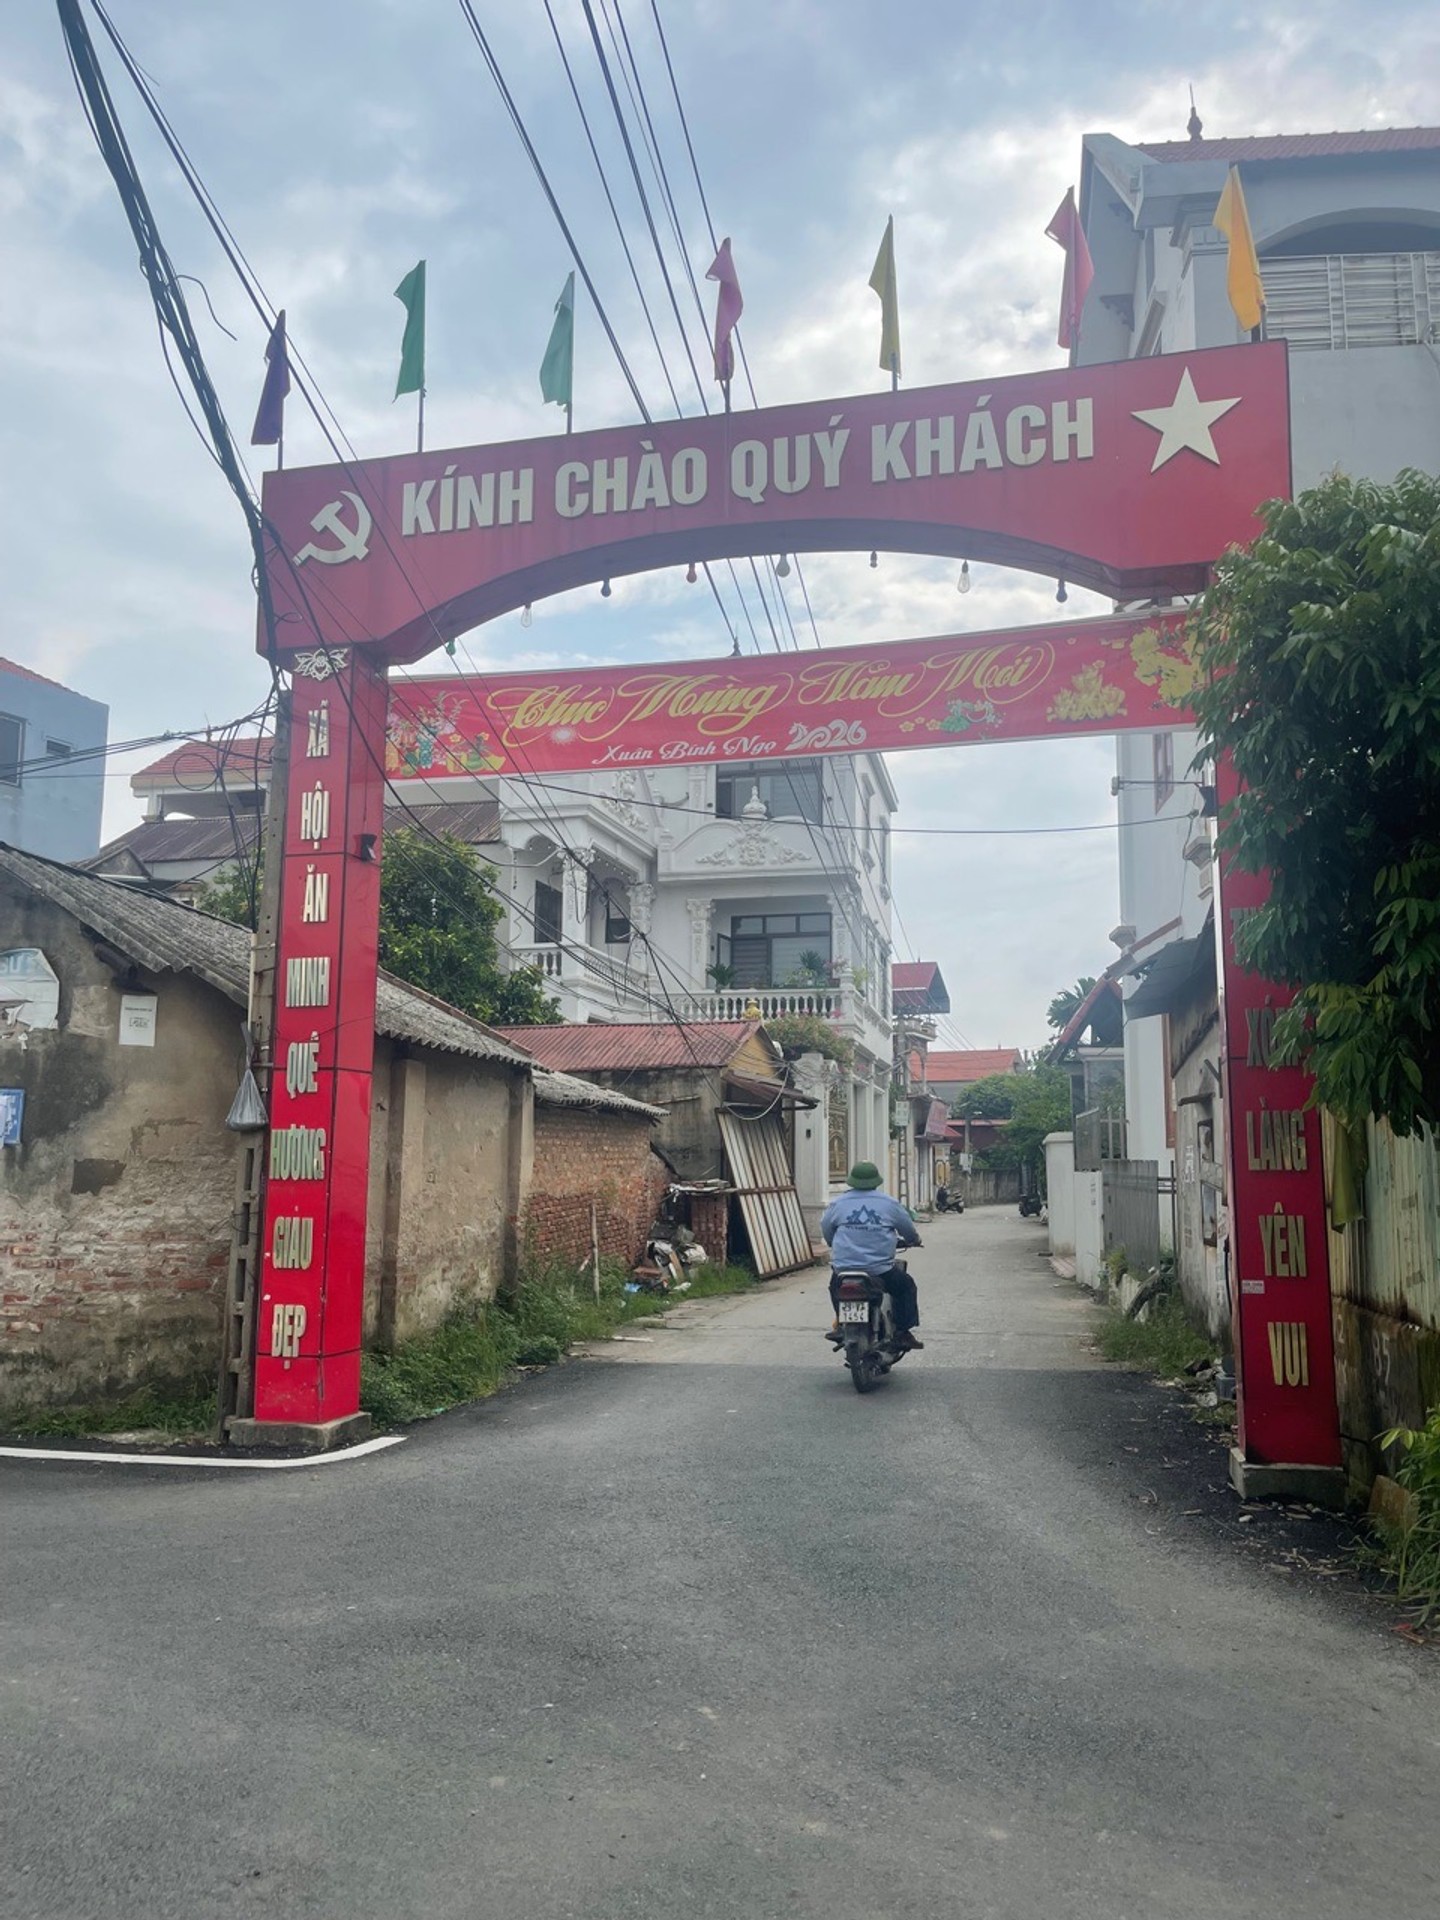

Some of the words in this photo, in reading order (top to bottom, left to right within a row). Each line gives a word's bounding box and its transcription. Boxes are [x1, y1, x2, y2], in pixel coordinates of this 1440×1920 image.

[402, 464, 534, 536] KÍNH
[554, 440, 708, 519] CHÀO
[730, 413, 851, 504] QUÝ
[871, 393, 1095, 483] KHÁCH
[306, 698, 330, 758] XÃ
[486, 684, 616, 748] Chúc
[578, 671, 794, 738] Mừng
[798, 659, 926, 704] Năm
[880, 640, 1056, 717] Mới
[591, 744, 653, 764] Xuân
[722, 735, 777, 756] Ngọ
[784, 719, 867, 751] 2026
[300, 780, 330, 850] HỘI
[285, 956, 331, 1008] MINH
[286, 1030, 320, 1099] QUÊ
[268, 1123, 327, 1181] HƯƠNG
[1246, 1095, 1308, 1171] LÀNG
[1258, 1201, 1308, 1278] YÊN
[271, 1303, 307, 1370] ĐẸP
[1267, 1321, 1310, 1388] VUI
